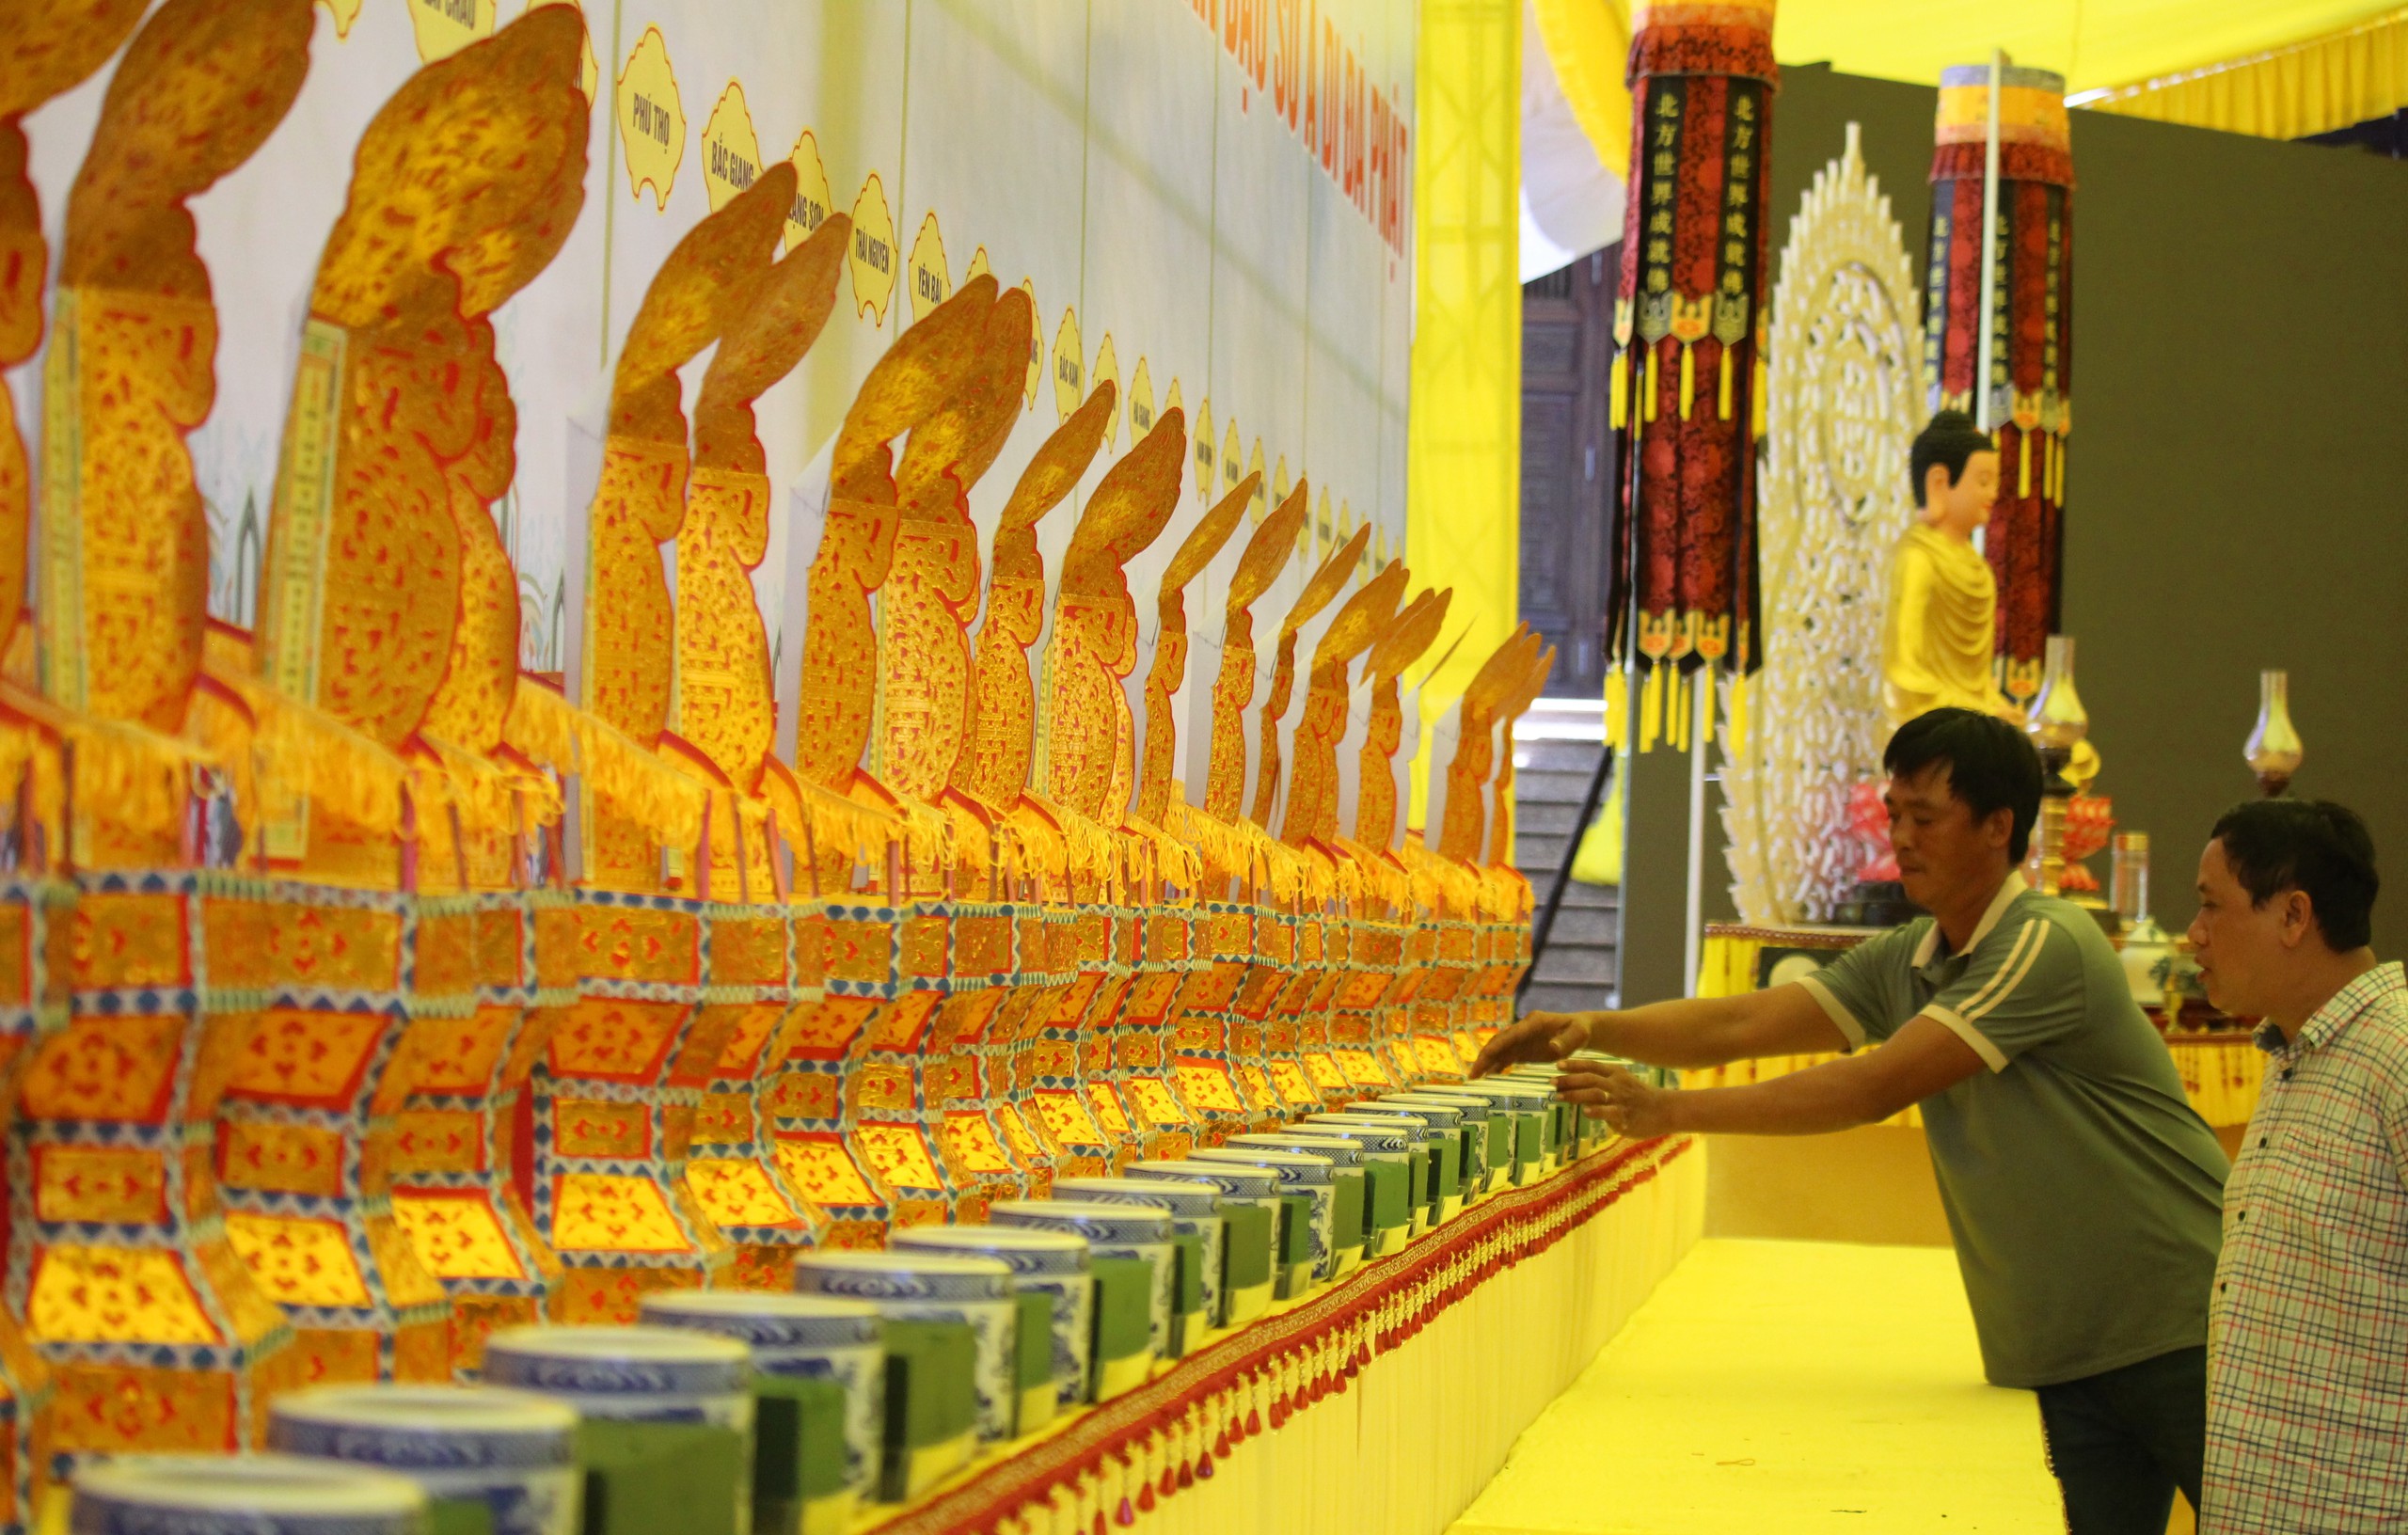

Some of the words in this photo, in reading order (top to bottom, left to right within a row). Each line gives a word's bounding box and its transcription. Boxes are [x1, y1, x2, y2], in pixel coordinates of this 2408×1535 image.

[633, 92, 651, 135] PHÚ
[653, 104, 670, 154] THỌ
[711, 132, 728, 182] BẮC
[855, 225, 867, 264] THÁI
